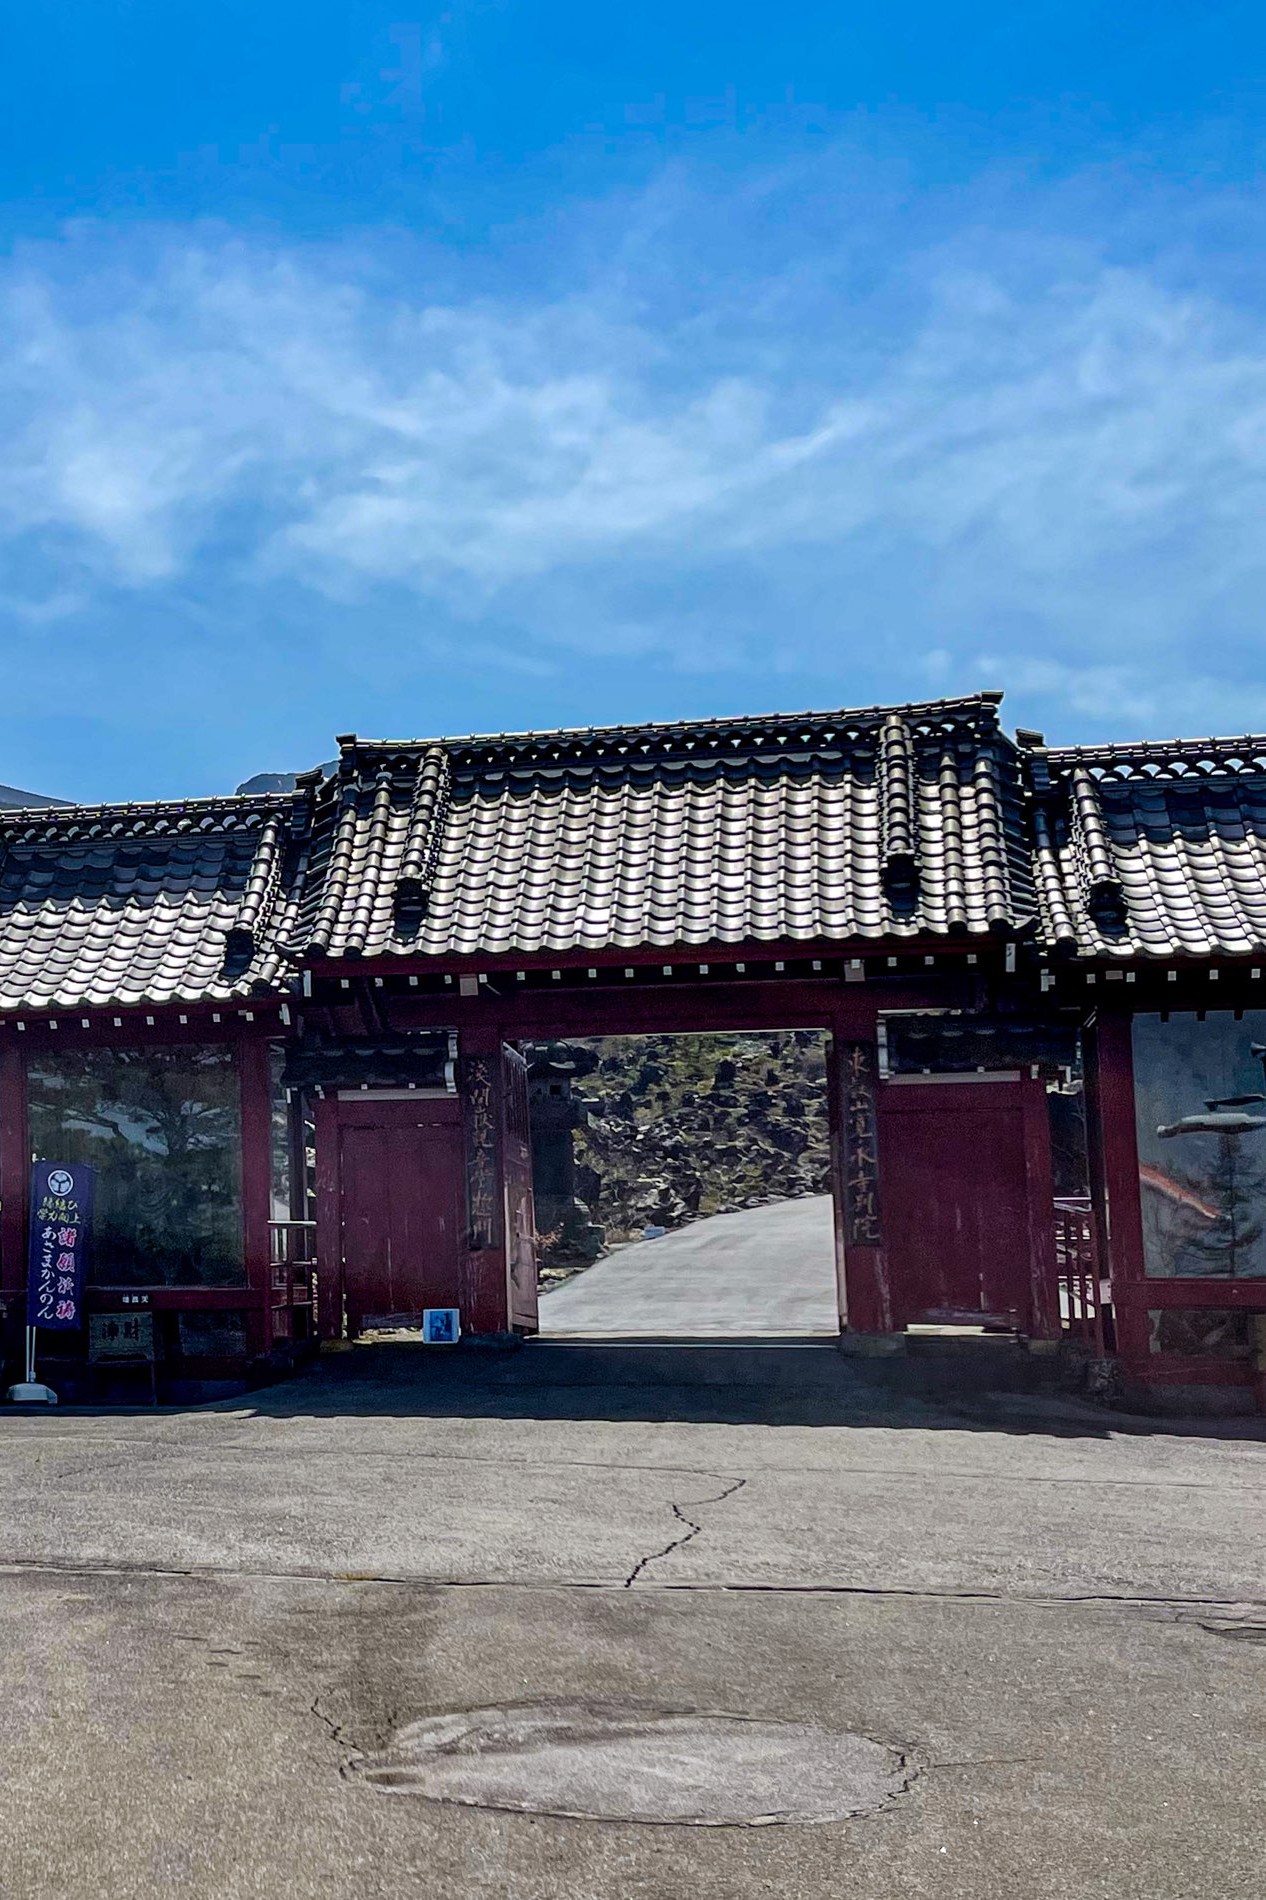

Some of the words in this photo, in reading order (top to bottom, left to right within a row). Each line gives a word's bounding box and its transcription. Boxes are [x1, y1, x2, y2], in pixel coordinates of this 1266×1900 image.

[37, 1225, 57, 1320] あさまかんのん
